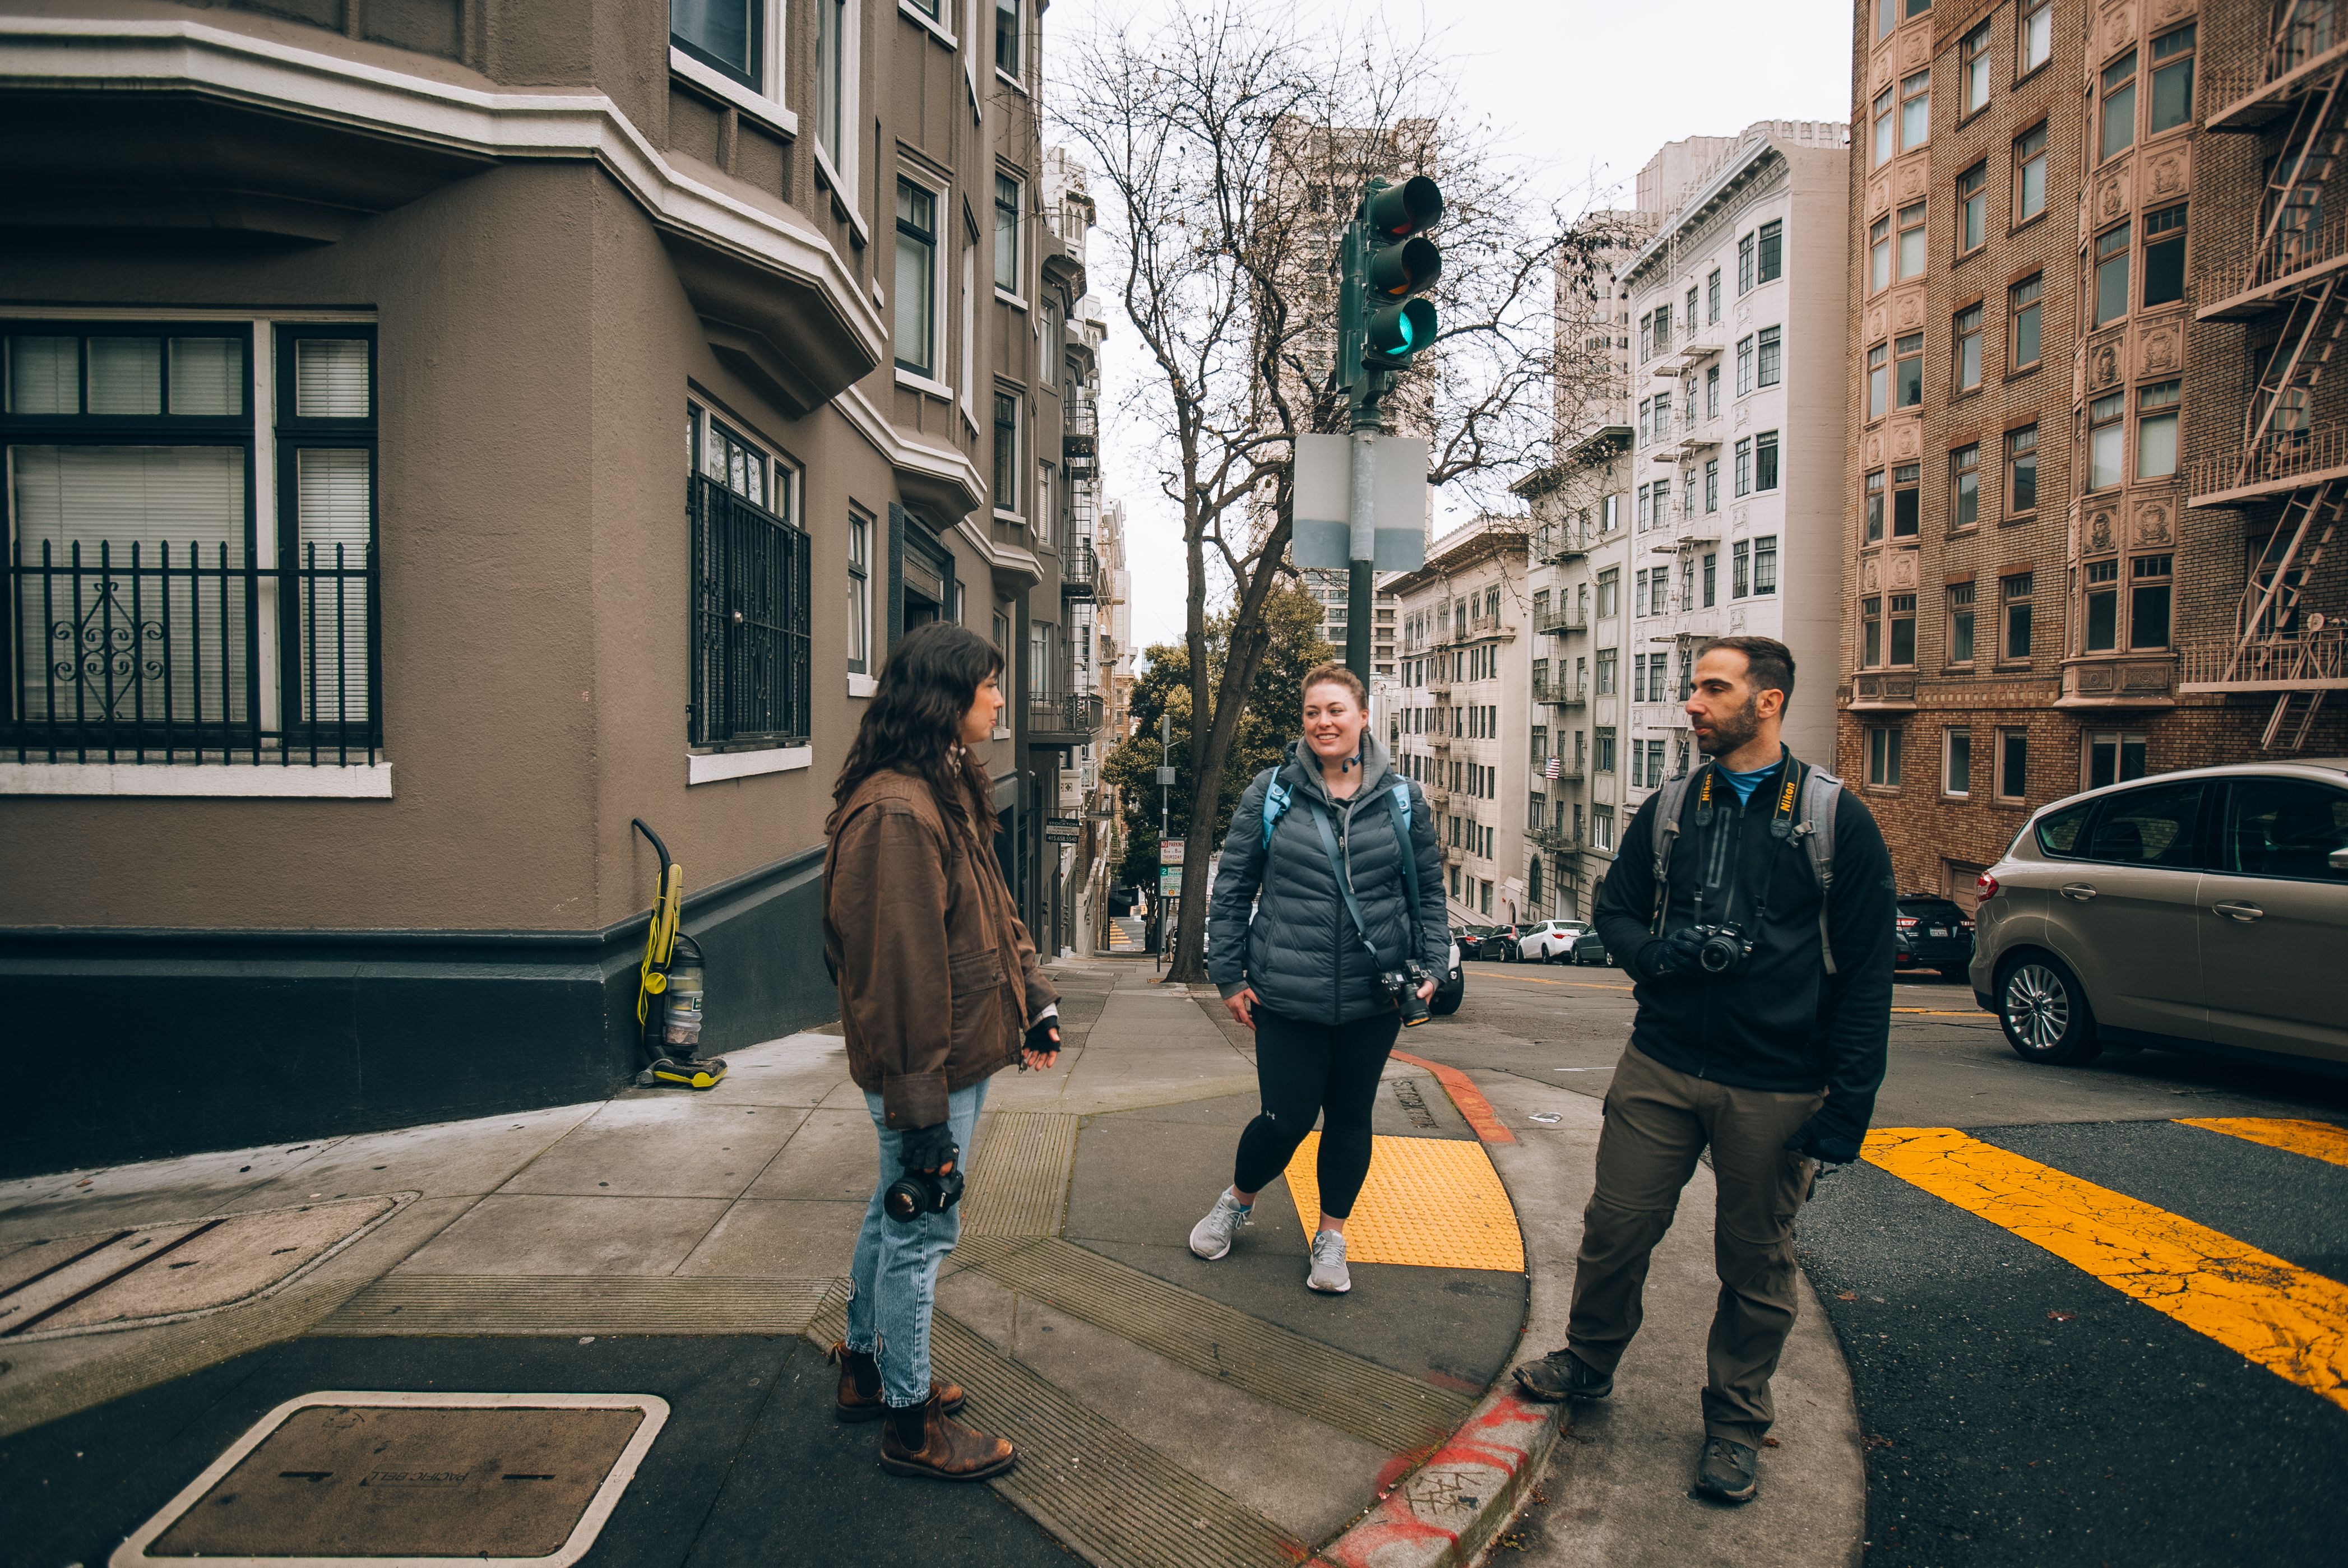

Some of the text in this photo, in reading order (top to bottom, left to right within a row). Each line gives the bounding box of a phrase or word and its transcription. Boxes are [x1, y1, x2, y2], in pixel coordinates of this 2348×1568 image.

[1702, 774, 1712, 801] Nikon
[1780, 782, 1795, 812] Nikon
[371, 1471, 469, 1481] PACIFIC BELL
